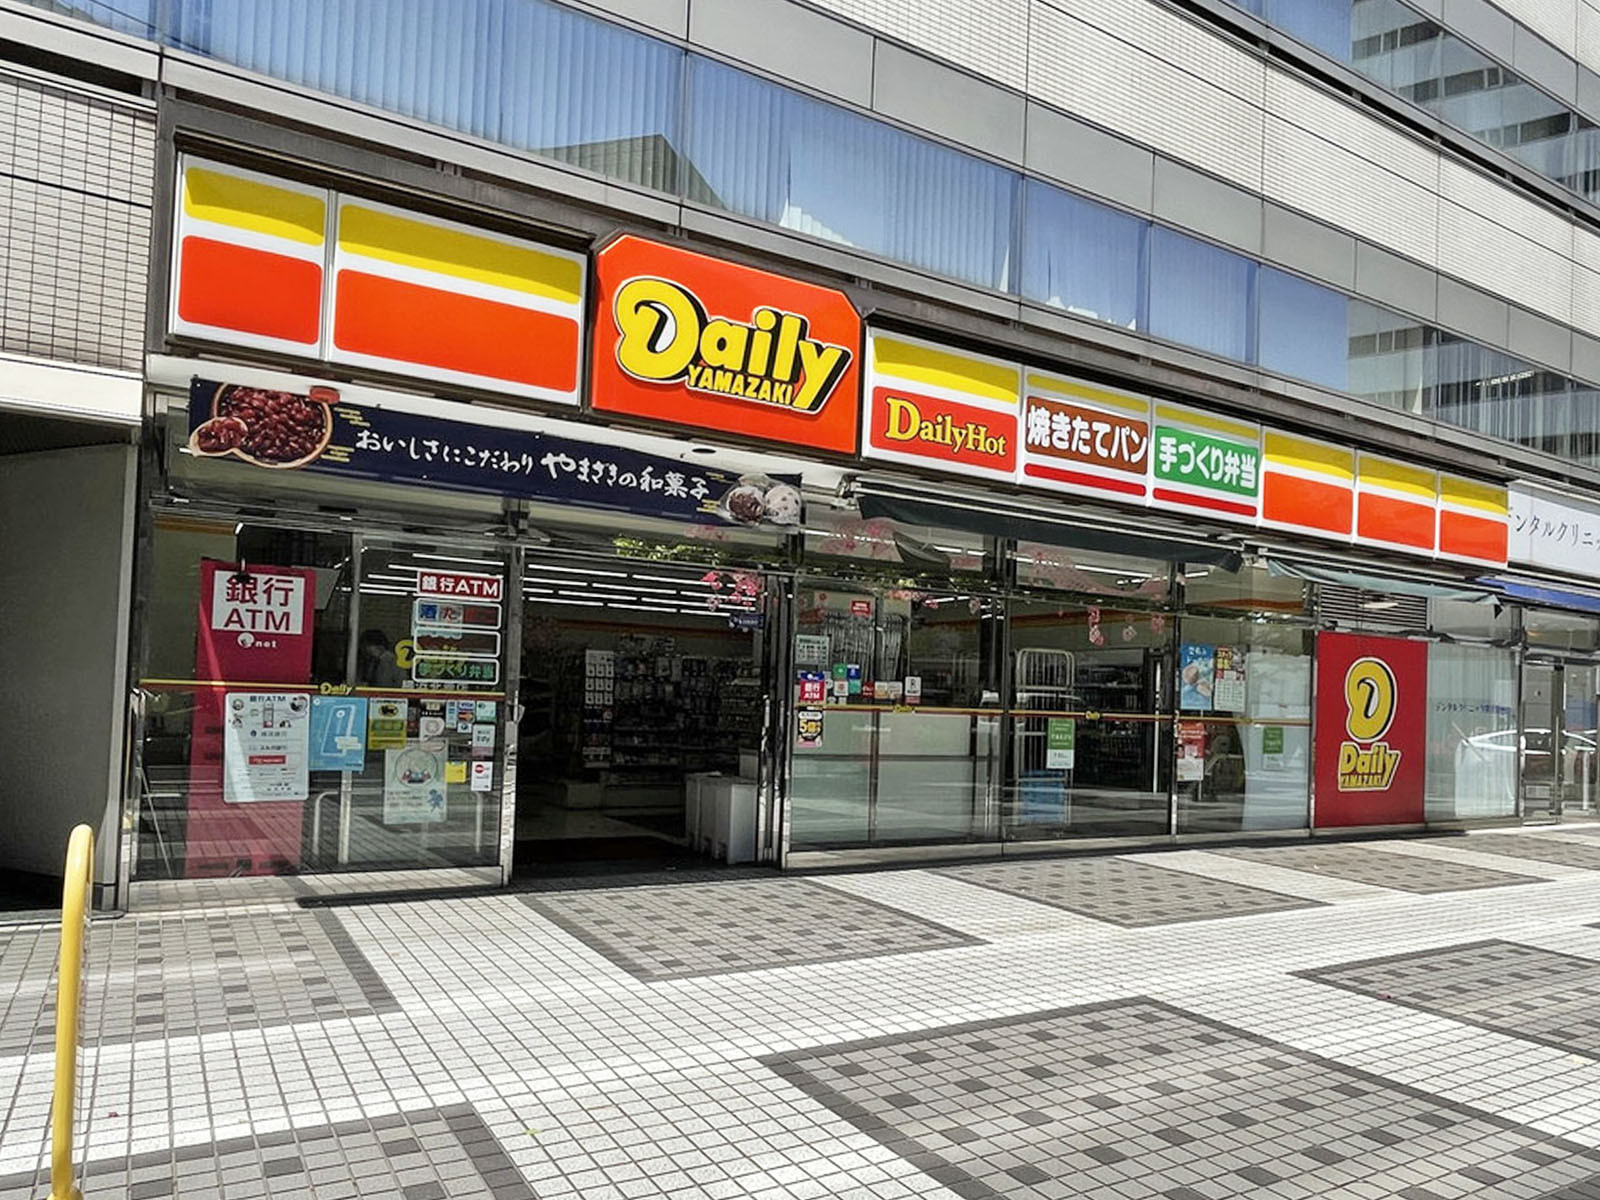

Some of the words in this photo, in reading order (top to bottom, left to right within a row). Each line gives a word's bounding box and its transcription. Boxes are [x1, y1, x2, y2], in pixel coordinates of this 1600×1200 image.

[614, 276, 851, 412] Daily
[687, 363, 795, 407] YAMAZAKI
[885, 395, 1007, 458] DailyHot
[1027, 404, 1148, 464] 焼きたてパン
[355, 429, 534, 475] おいしさにこだわり
[540, 451, 710, 499] やまざきの和菓子
[1159, 435, 1257, 490] 手づくり弁当
[1508, 506, 1600, 552] ンタルクリニ
[226, 574, 294, 607] 銀行
[421, 575, 499, 597] 銀行ATM
[223, 608, 291, 632] ATM
[1340, 742, 1400, 788] Daily
